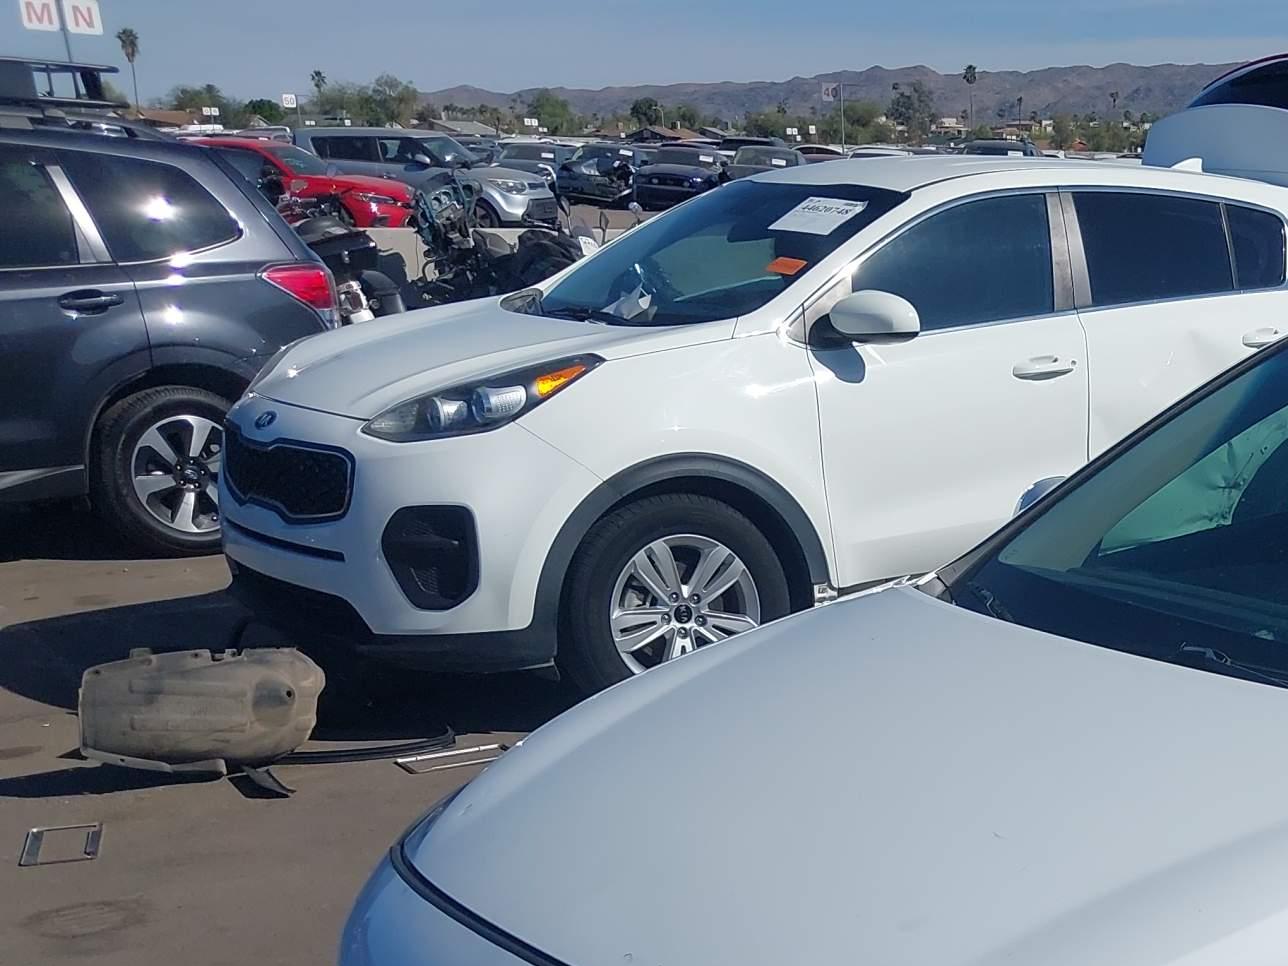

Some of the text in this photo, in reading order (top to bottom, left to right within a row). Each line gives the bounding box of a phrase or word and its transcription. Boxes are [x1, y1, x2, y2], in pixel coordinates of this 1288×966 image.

[25, 1, 95, 29] M N
[823, 87, 838, 98] 40
[284, 98, 295, 106] 50
